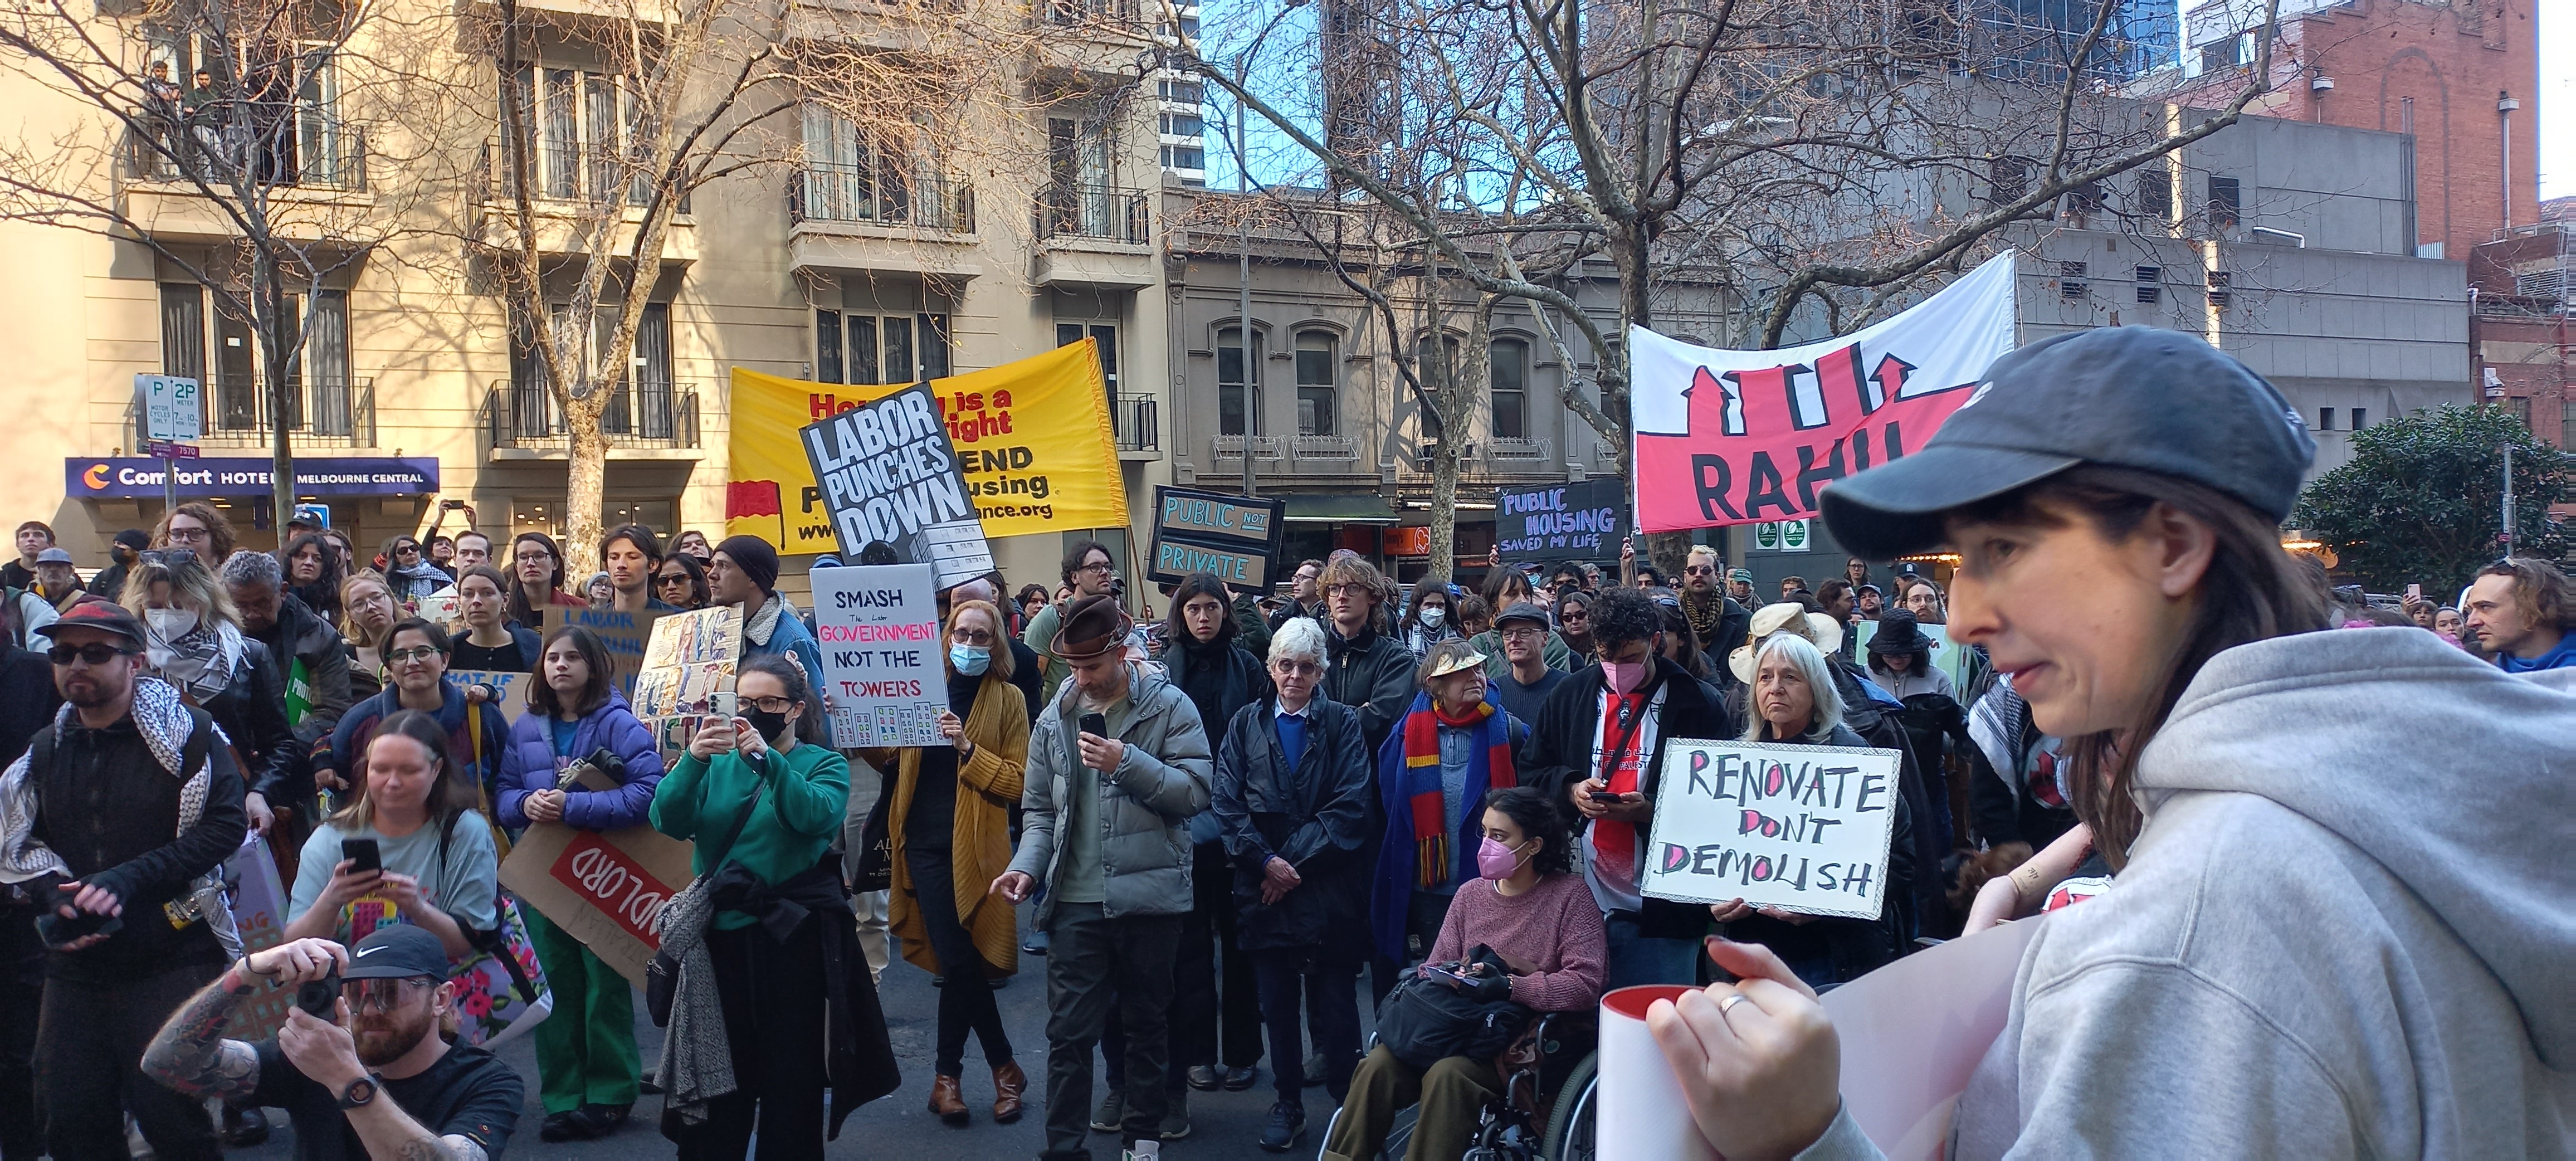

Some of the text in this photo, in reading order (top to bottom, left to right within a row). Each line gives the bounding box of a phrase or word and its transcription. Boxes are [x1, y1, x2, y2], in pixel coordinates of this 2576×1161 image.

[153, 381, 164, 396] P
[175, 383, 195, 399] 2P
[954, 391, 984, 412] is
[992, 389, 1012, 408] a
[808, 390, 939, 474] LABOR
[118, 467, 212, 486] Comfort
[297, 474, 369, 484] MELBOURNE
[372, 473, 423, 483] CENTRAL
[823, 435, 950, 510] PUNCHES
[1164, 497, 1268, 527] PUBLIC NOT
[1504, 487, 1568, 516] PUBLIC
[836, 471, 967, 557] DOWN
[1525, 507, 1616, 536] HOUSING
[1500, 533, 1600, 552] SAVED MY LIFE
[1159, 544, 1249, 580] PRIVATE
[835, 589, 904, 609] SMASH
[849, 614, 862, 623] The
[819, 622, 936, 642] GOVERNMENT
[835, 650, 921, 669] NOT THE
[492, 674, 515, 686] IF
[840, 680, 922, 698] TOWERS
[1688, 750, 1886, 813] RENOVATE
[1653, 841, 1872, 898] DEMOLISH
